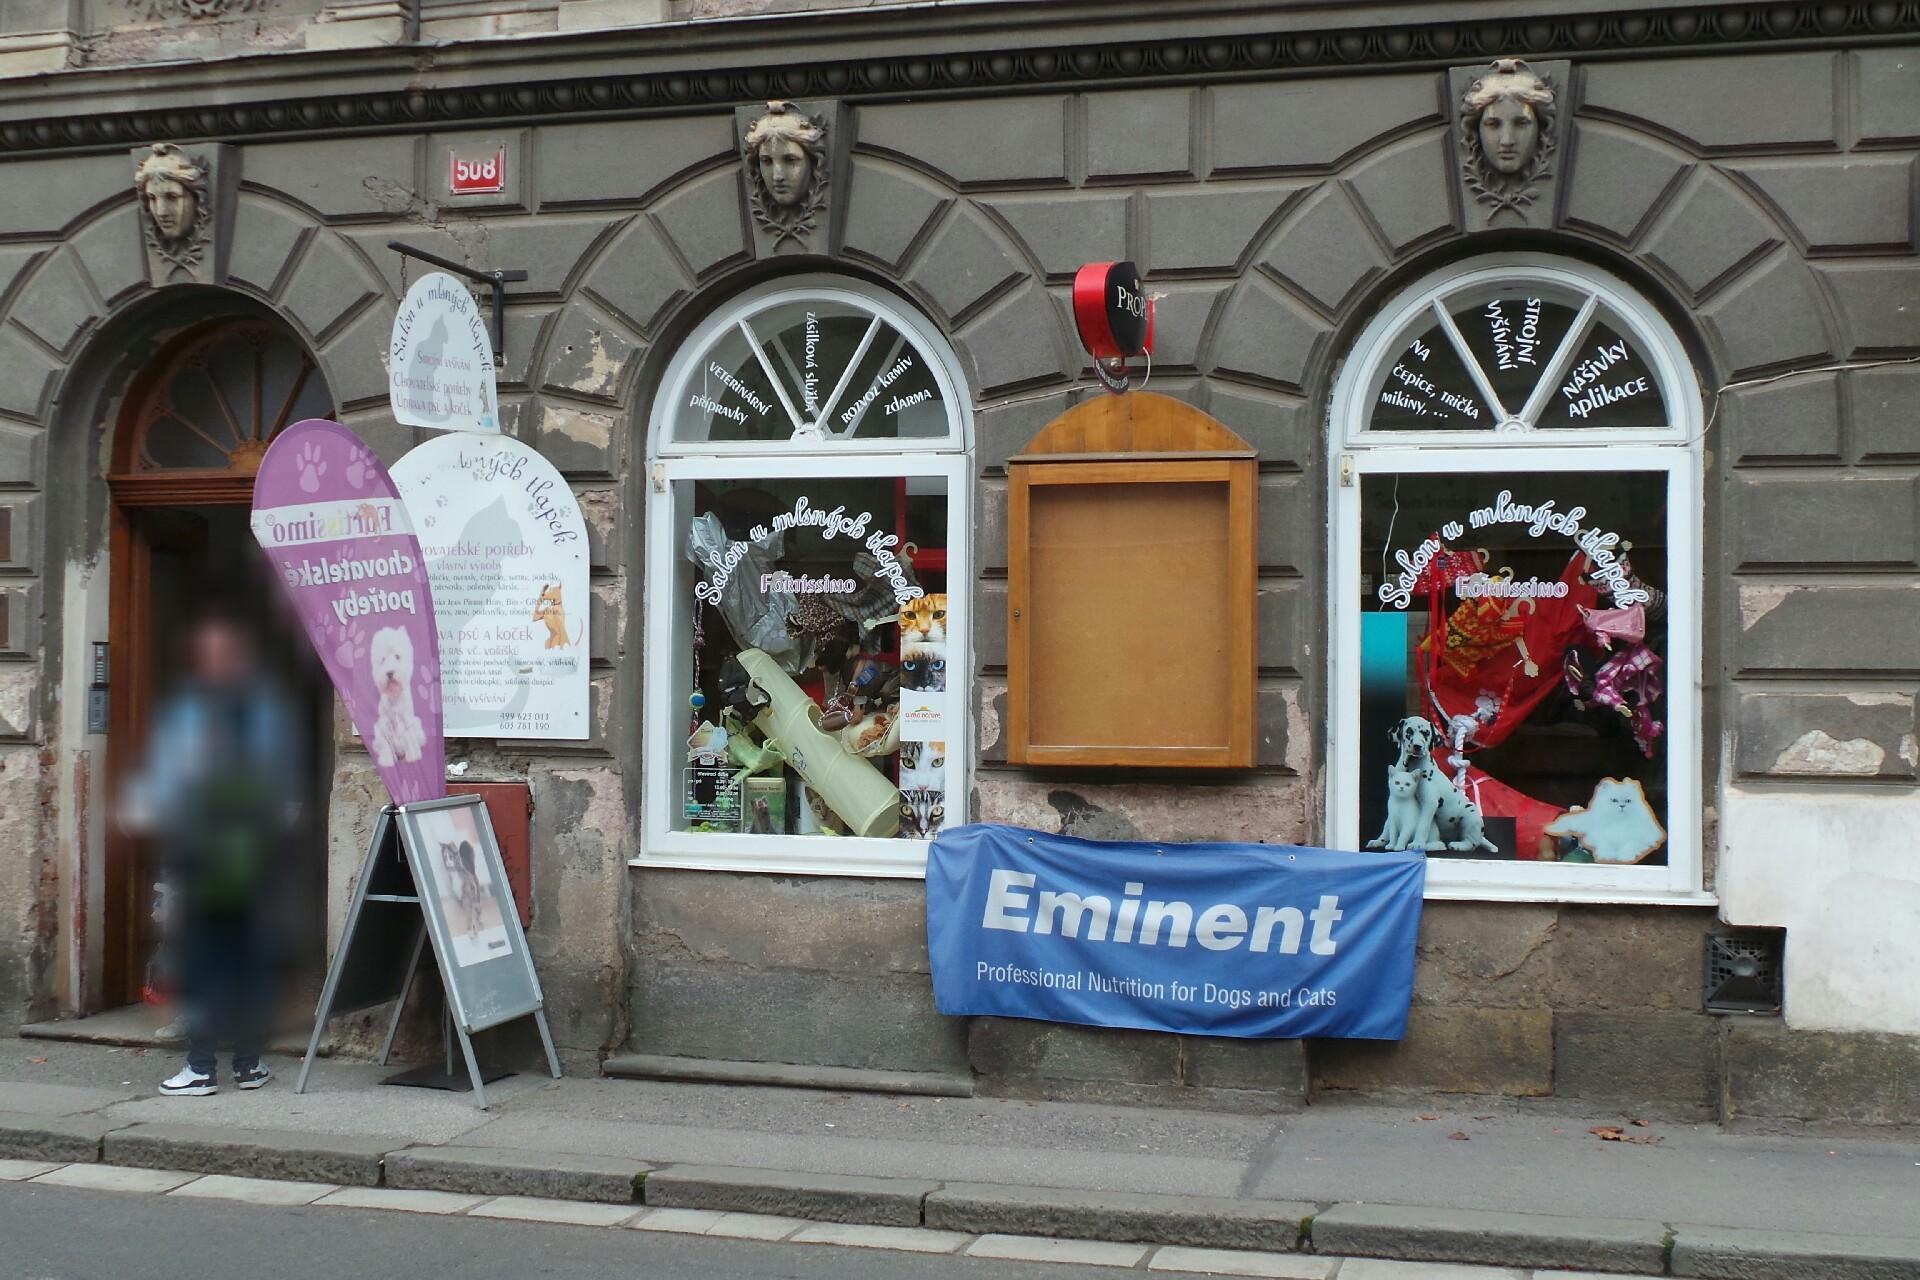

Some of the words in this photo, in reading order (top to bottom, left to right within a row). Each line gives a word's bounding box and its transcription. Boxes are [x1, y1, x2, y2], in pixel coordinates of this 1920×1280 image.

[457, 159, 496, 181] 508
[394, 310, 415, 361] Salon
[428, 277, 470, 314] mlsných
[468, 314, 492, 373] tlapek
[1409, 339, 1431, 362] NA
[840, 386, 882, 424] ROZVOZ
[526, 477, 577, 546] tlapek
[695, 542, 749, 606] Salon
[749, 524, 768, 543] u
[772, 496, 872, 540] mlsných
[866, 530, 924, 606] tlapek
[1378, 536, 1441, 610] Salon
[1442, 520, 1464, 541] u
[1469, 489, 1587, 538] mlsných
[1580, 527, 1650, 610] tlapek
[981, 868, 1344, 956] Eminent
[977, 961, 1082, 991] Professional
[1088, 971, 1164, 1000] Nutrition
[1170, 980, 1198, 1002] for
[1204, 983, 1251, 1009] Dogs
[1257, 988, 1291, 1008] and
[1298, 987, 1337, 1007] Cats
